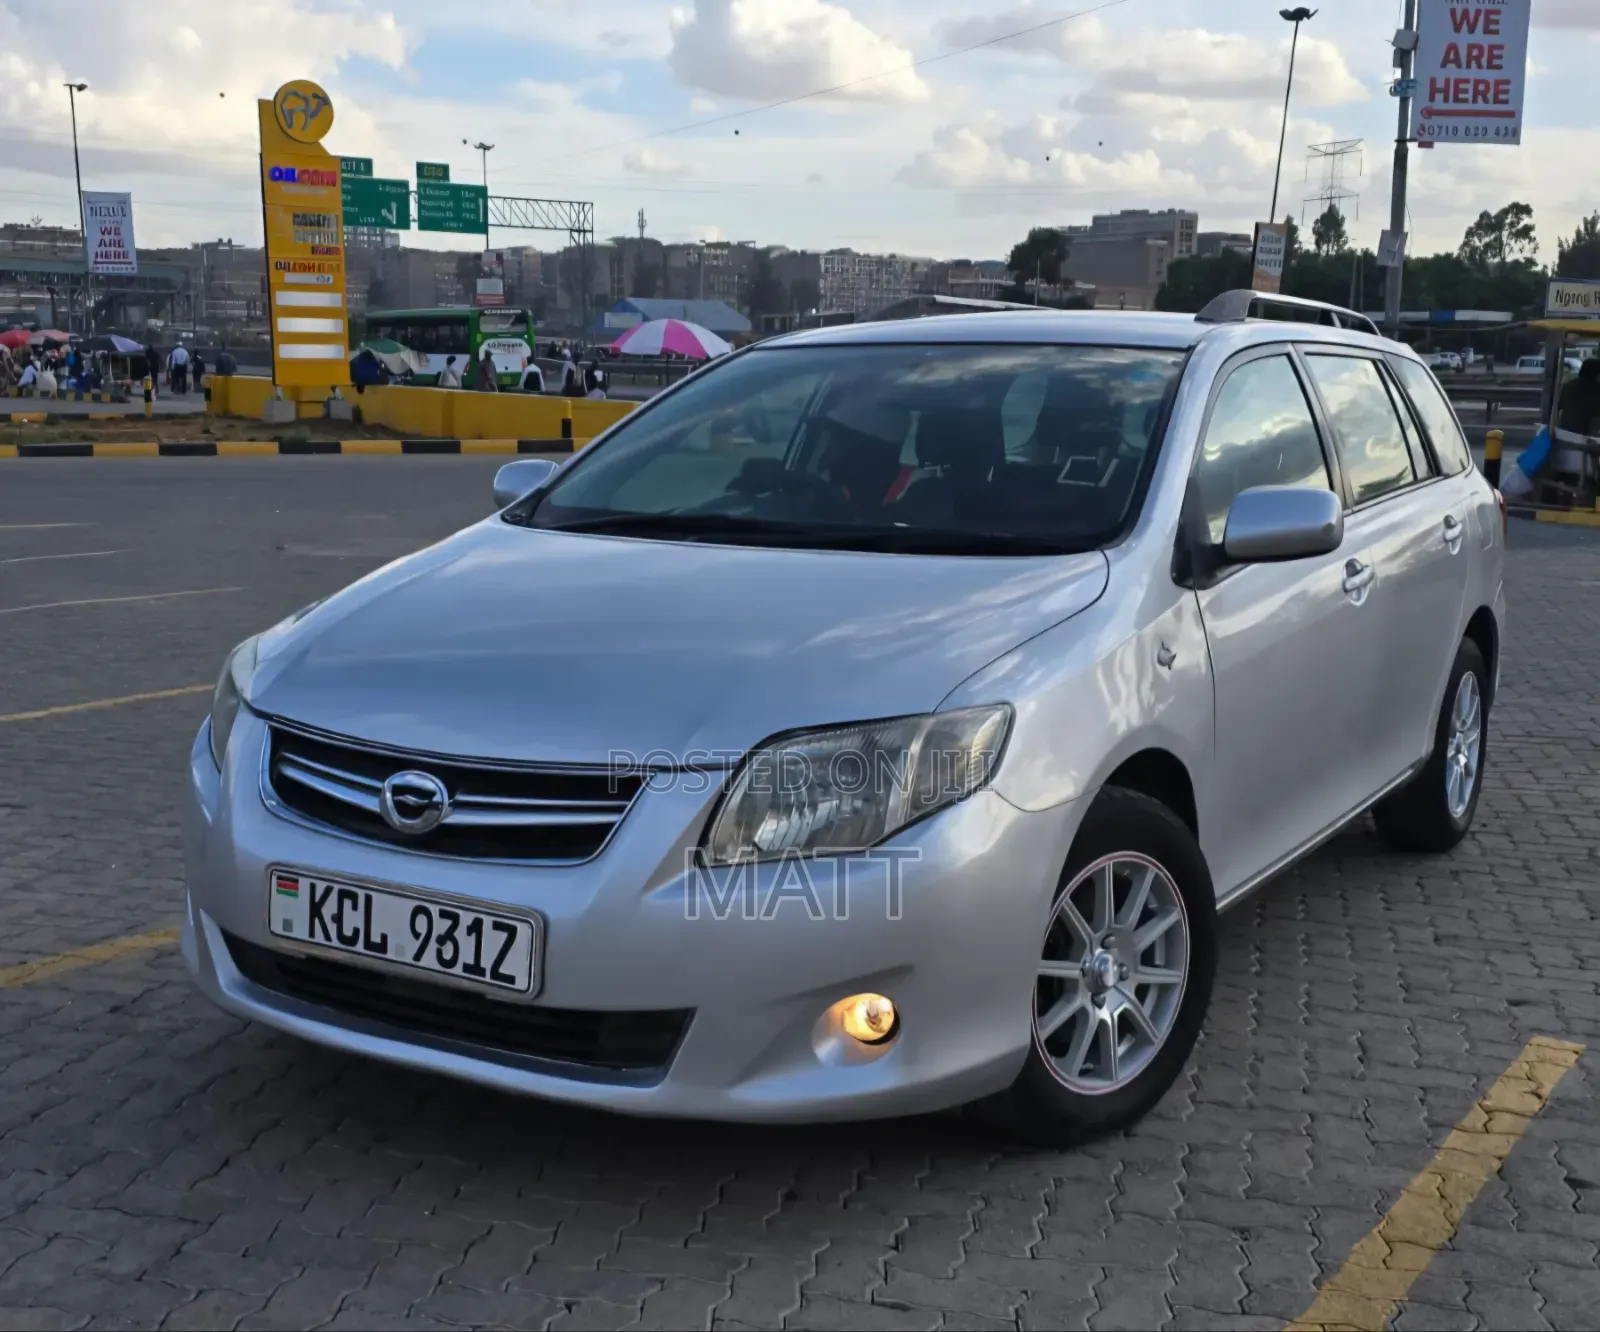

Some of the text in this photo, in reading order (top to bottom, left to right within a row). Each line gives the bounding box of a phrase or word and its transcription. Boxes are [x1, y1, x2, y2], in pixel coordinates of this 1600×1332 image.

[1449, 7, 1502, 35] WE
[1440, 42, 1504, 70] ARE
[1428, 76, 1511, 105] HERE
[308, 882, 518, 986] KCL 931Z
